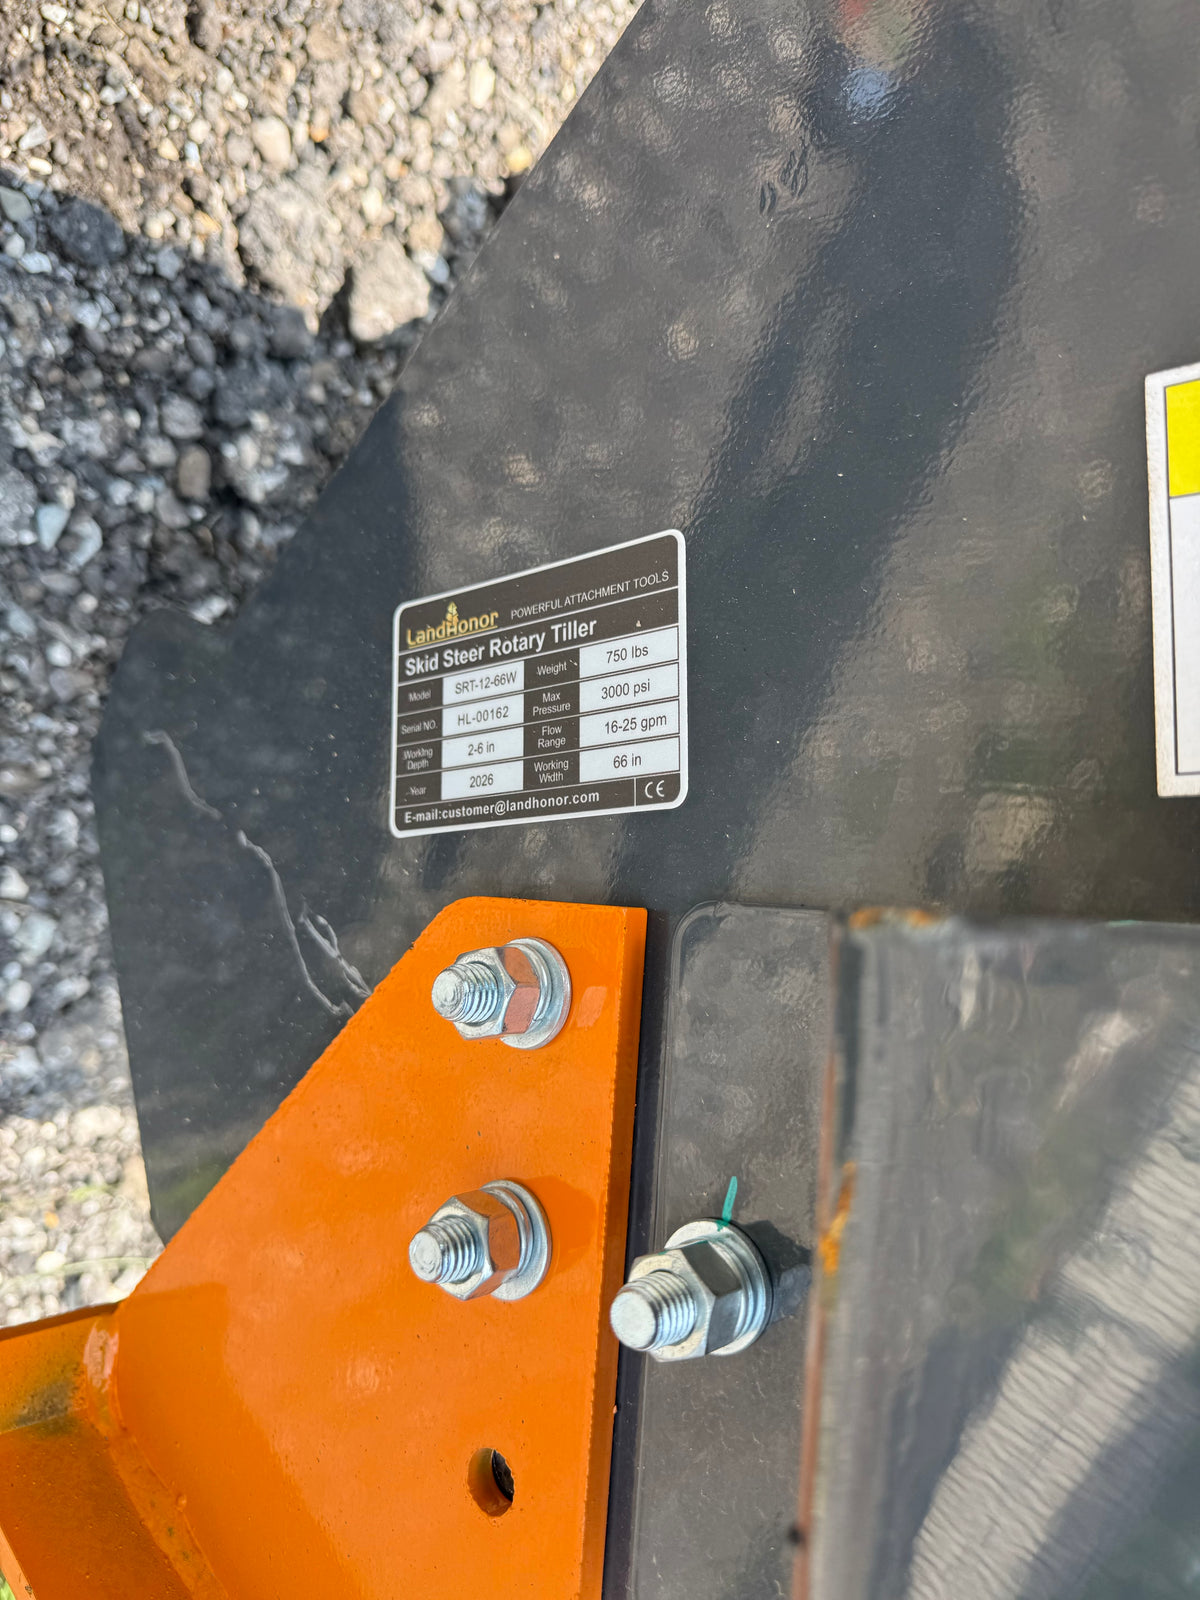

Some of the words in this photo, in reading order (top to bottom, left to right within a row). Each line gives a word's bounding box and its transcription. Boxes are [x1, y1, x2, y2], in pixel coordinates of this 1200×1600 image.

[510, 598, 563, 620] POWERFUL
[564, 581, 631, 606] ATTACHMENT
[633, 570, 670, 590] TOOLS
[407, 603, 499, 647] LandHonor
[405, 653, 439, 676] Skid
[443, 645, 485, 668] Steer
[489, 632, 546, 658] Rotary
[551, 620, 597, 643] Tiller
[606, 647, 628, 664] 750
[631, 645, 649, 659] lbs
[536, 661, 567, 676] Weight
[455, 671, 517, 695] SRT-12-66W
[601, 682, 630, 700] 3000
[633, 679, 651, 697] psi
[408, 690, 432, 702] Model
[542, 692, 561, 703] Max
[457, 705, 509, 727] HL-00162
[532, 702, 571, 716] Pressure
[401, 722, 422, 735] Serial
[541, 725, 563, 736] Flow
[604, 717, 637, 735] 16-25
[640, 714, 667, 732] gpm
[467, 742, 484, 757] 2-6
[486, 741, 495, 753] in
[537, 736, 566, 749] Range
[403, 747, 433, 761] Working
[613, 755, 628, 769] 66
[631, 753, 642, 767] in
[407, 760, 429, 771] Depth
[534, 759, 569, 772] Working
[469, 773, 494, 788] 2026
[539, 771, 564, 784] Width
[409, 786, 427, 796] Year
